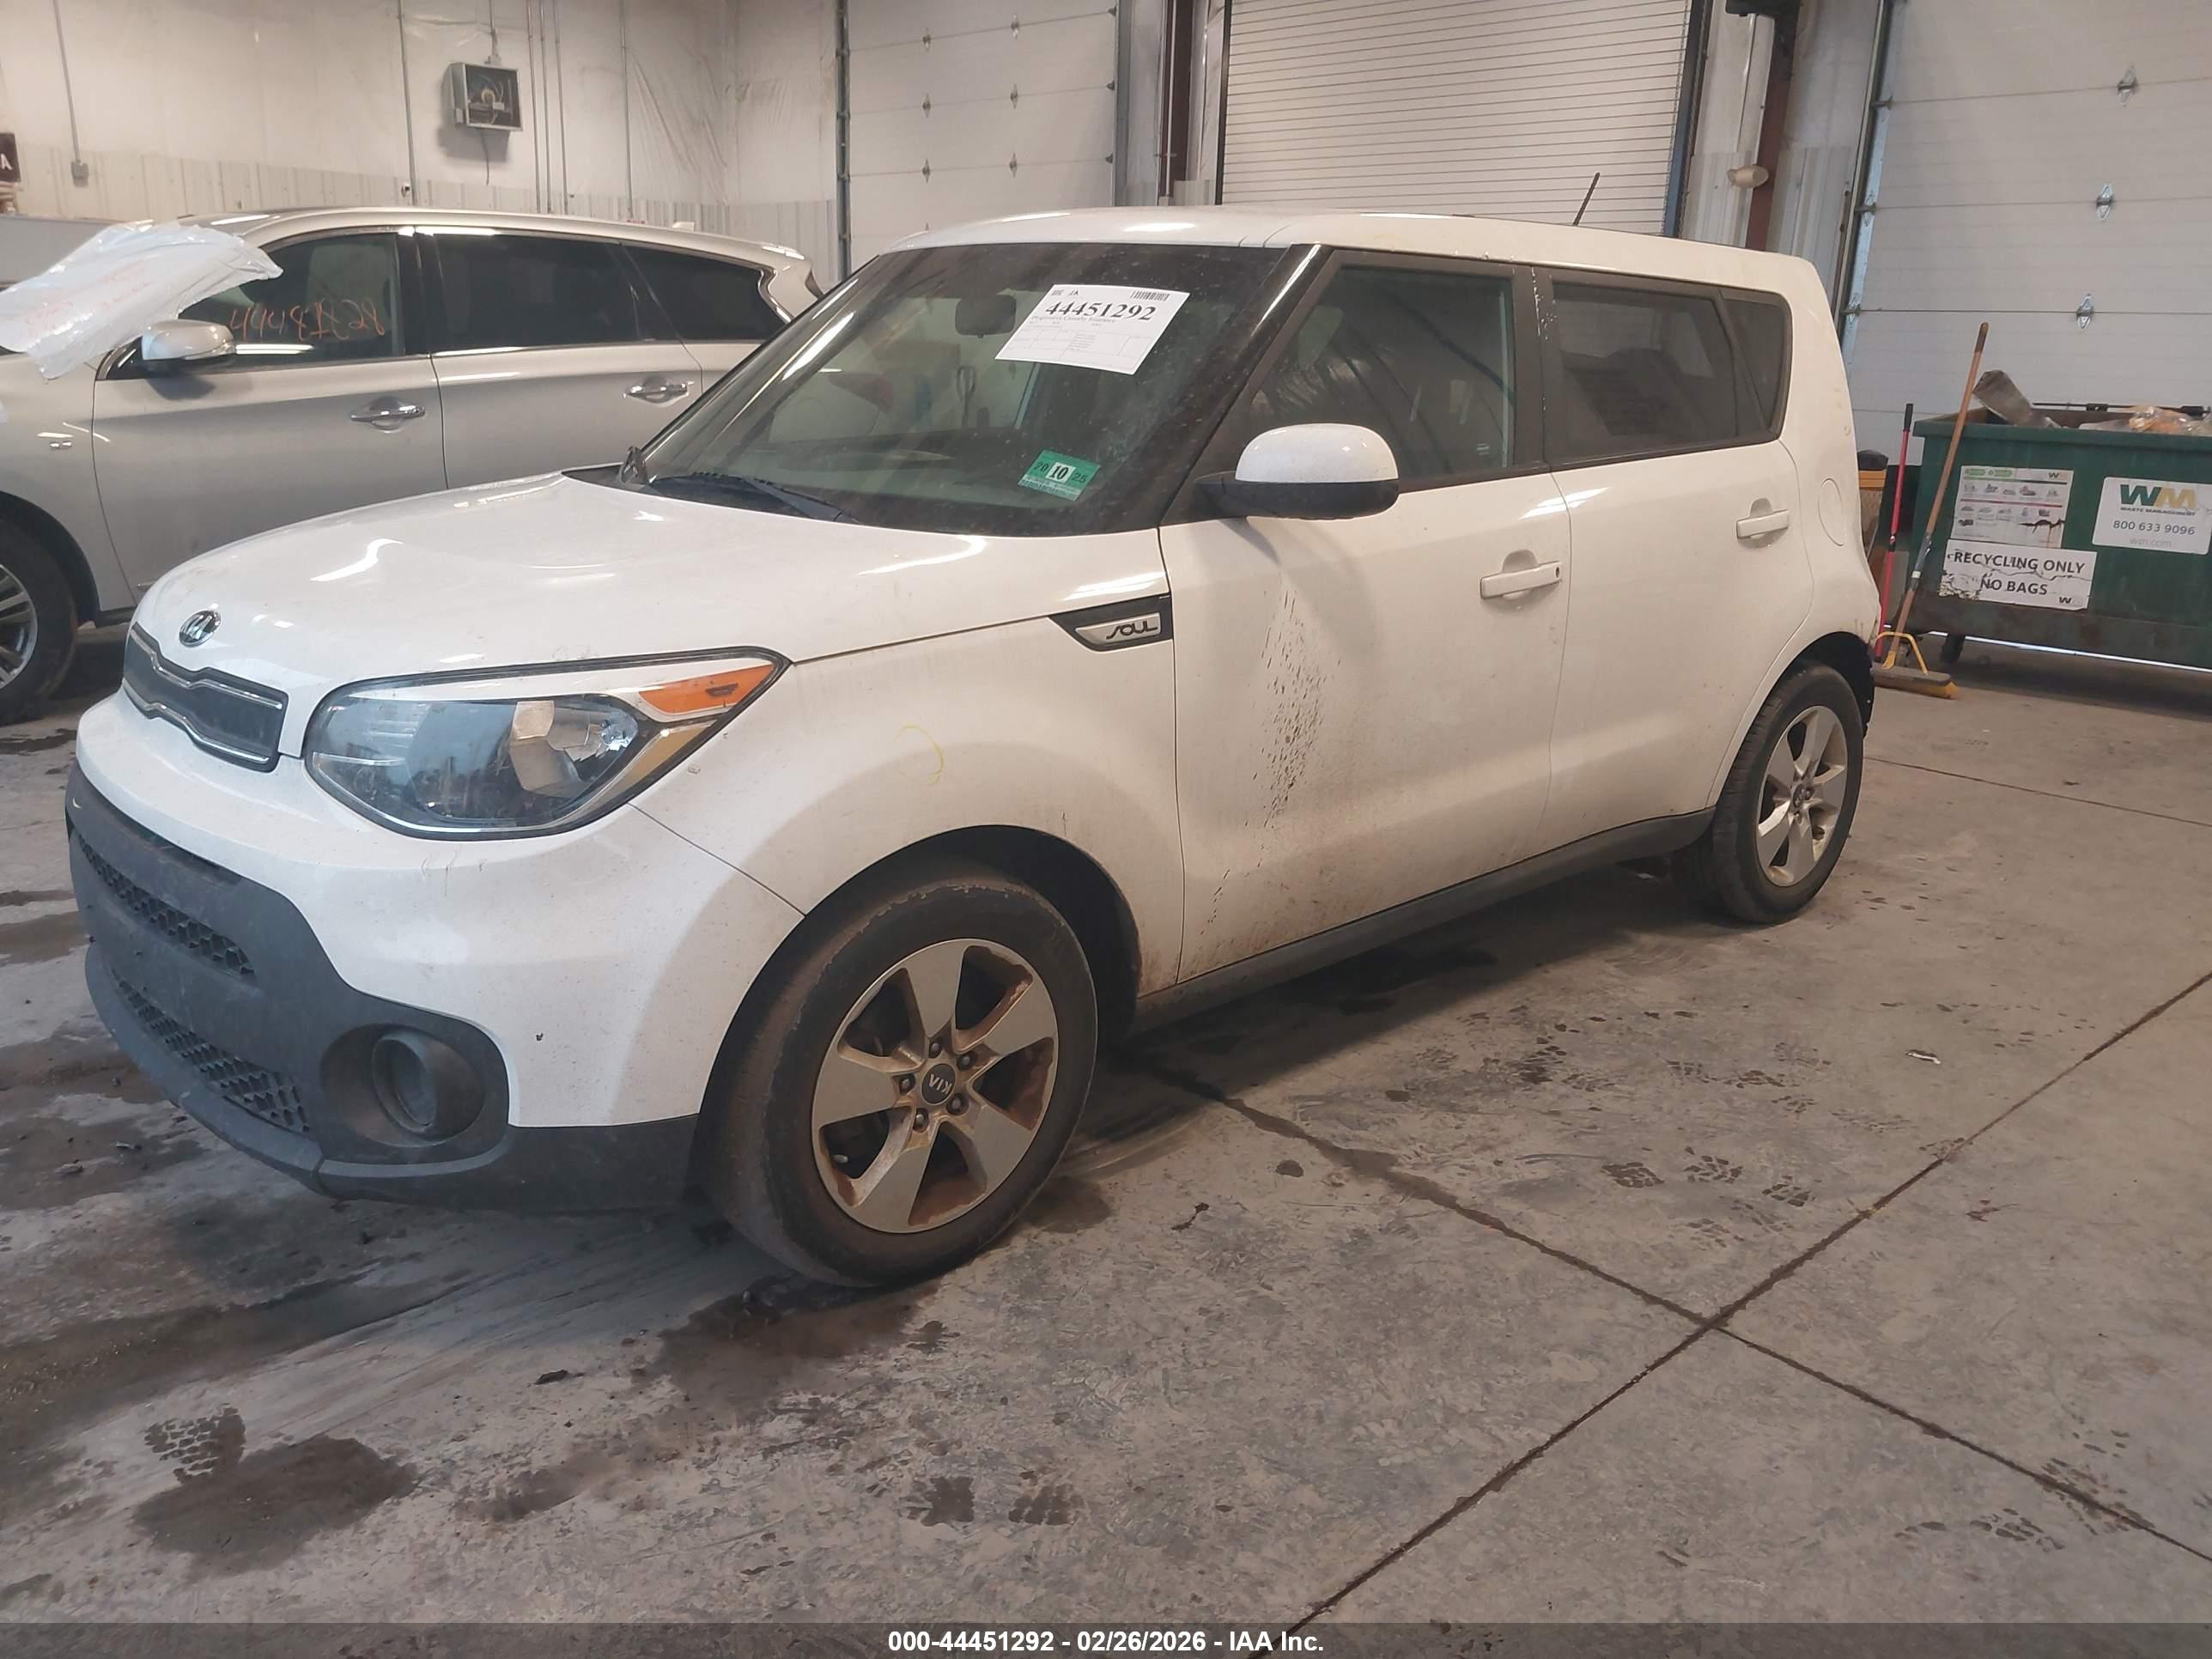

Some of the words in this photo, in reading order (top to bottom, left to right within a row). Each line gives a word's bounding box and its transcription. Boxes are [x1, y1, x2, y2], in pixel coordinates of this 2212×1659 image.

[1046, 301, 1157, 320] 44451292
[1049, 465, 1069, 480] 10
[2120, 483, 2197, 508] WM
[2113, 520, 2136, 530] 800
[2138, 522, 2160, 532] 633
[2164, 524, 2196, 535] 9096
[1954, 551, 2038, 570] RECYCLING
[2043, 559, 2085, 574] ONLY
[1979, 579, 2002, 591] NO
[2006, 581, 2048, 595] BAGS
[1106, 620, 1158, 640] SOUL
[928, 1073, 952, 1095] KIA
